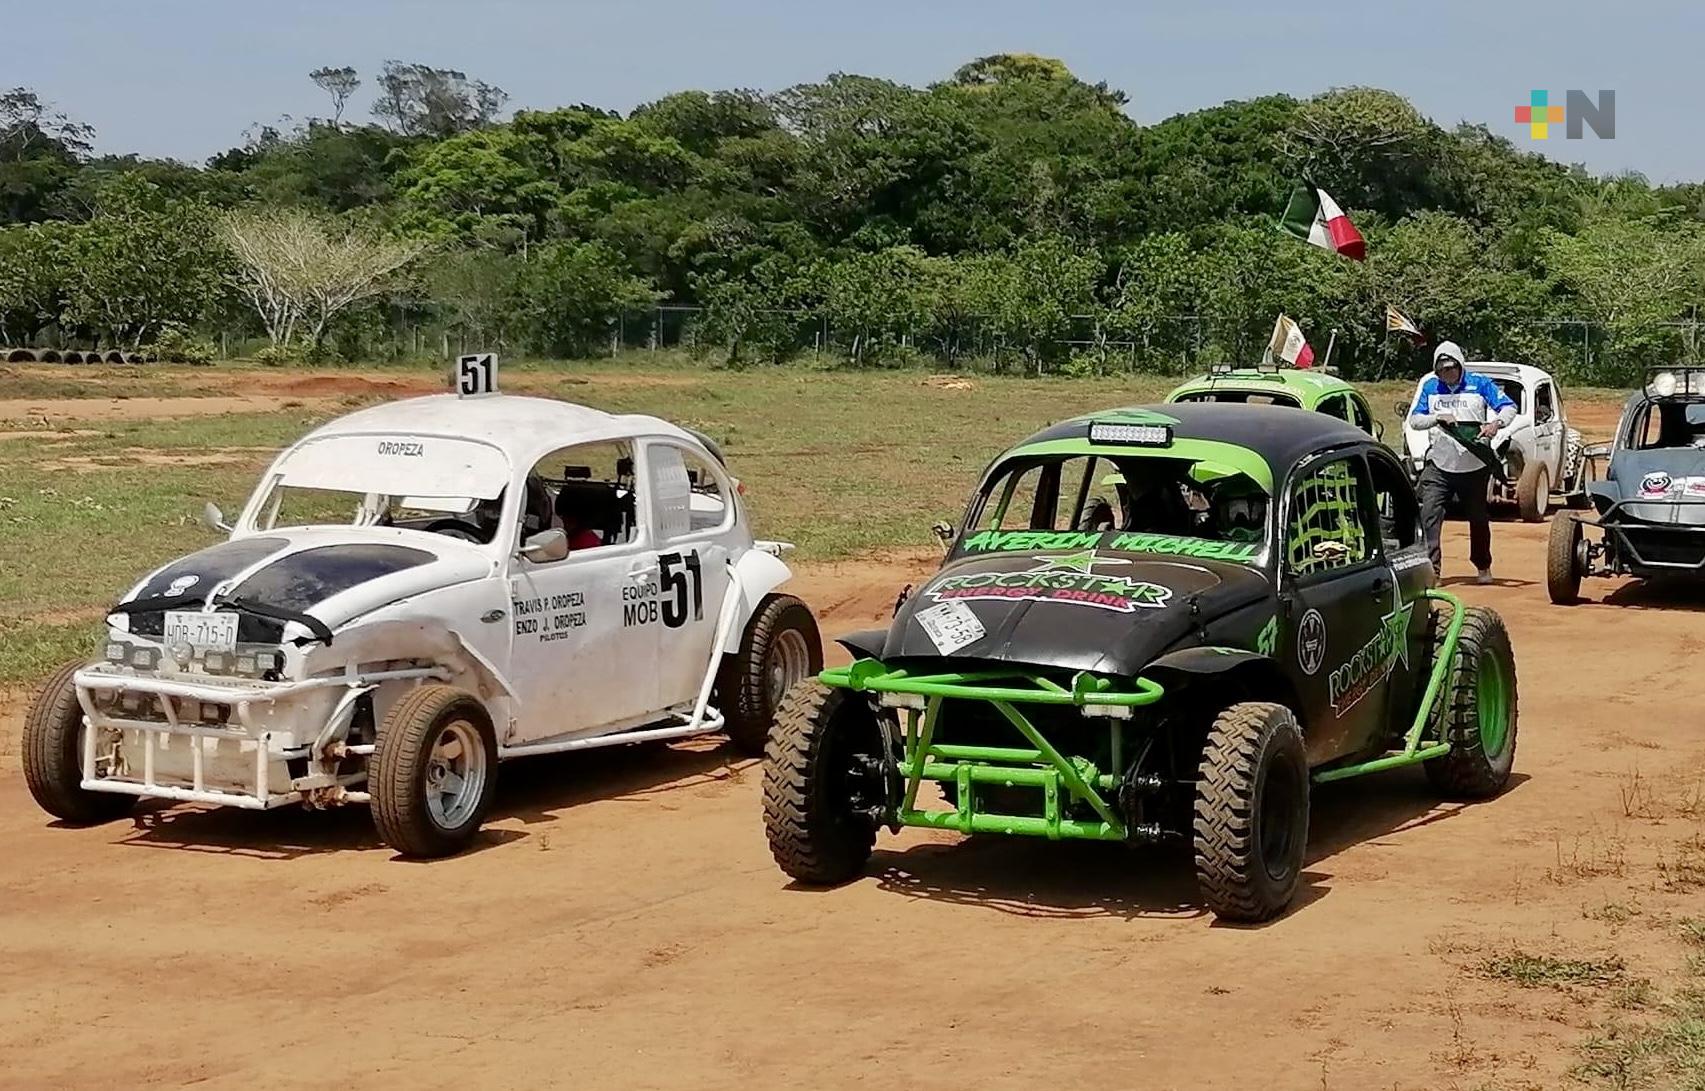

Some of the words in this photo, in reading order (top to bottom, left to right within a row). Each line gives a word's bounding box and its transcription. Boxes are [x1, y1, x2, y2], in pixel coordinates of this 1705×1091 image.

[462, 355, 492, 394] 51
[378, 442, 424, 457] OROPEZA
[622, 583, 658, 600] EQUIPO
[658, 549, 703, 628] 51
[941, 587, 1043, 599] ENERGY
[1053, 590, 1130, 609] DRINK
[513, 598, 542, 615] TRAVIS
[552, 592, 585, 610] OROPEZA
[624, 600, 658, 627] MOB
[516, 619, 538, 635] ENZO
[555, 612, 587, 630] OROPEZA
[540, 631, 568, 642] PILOTOS
